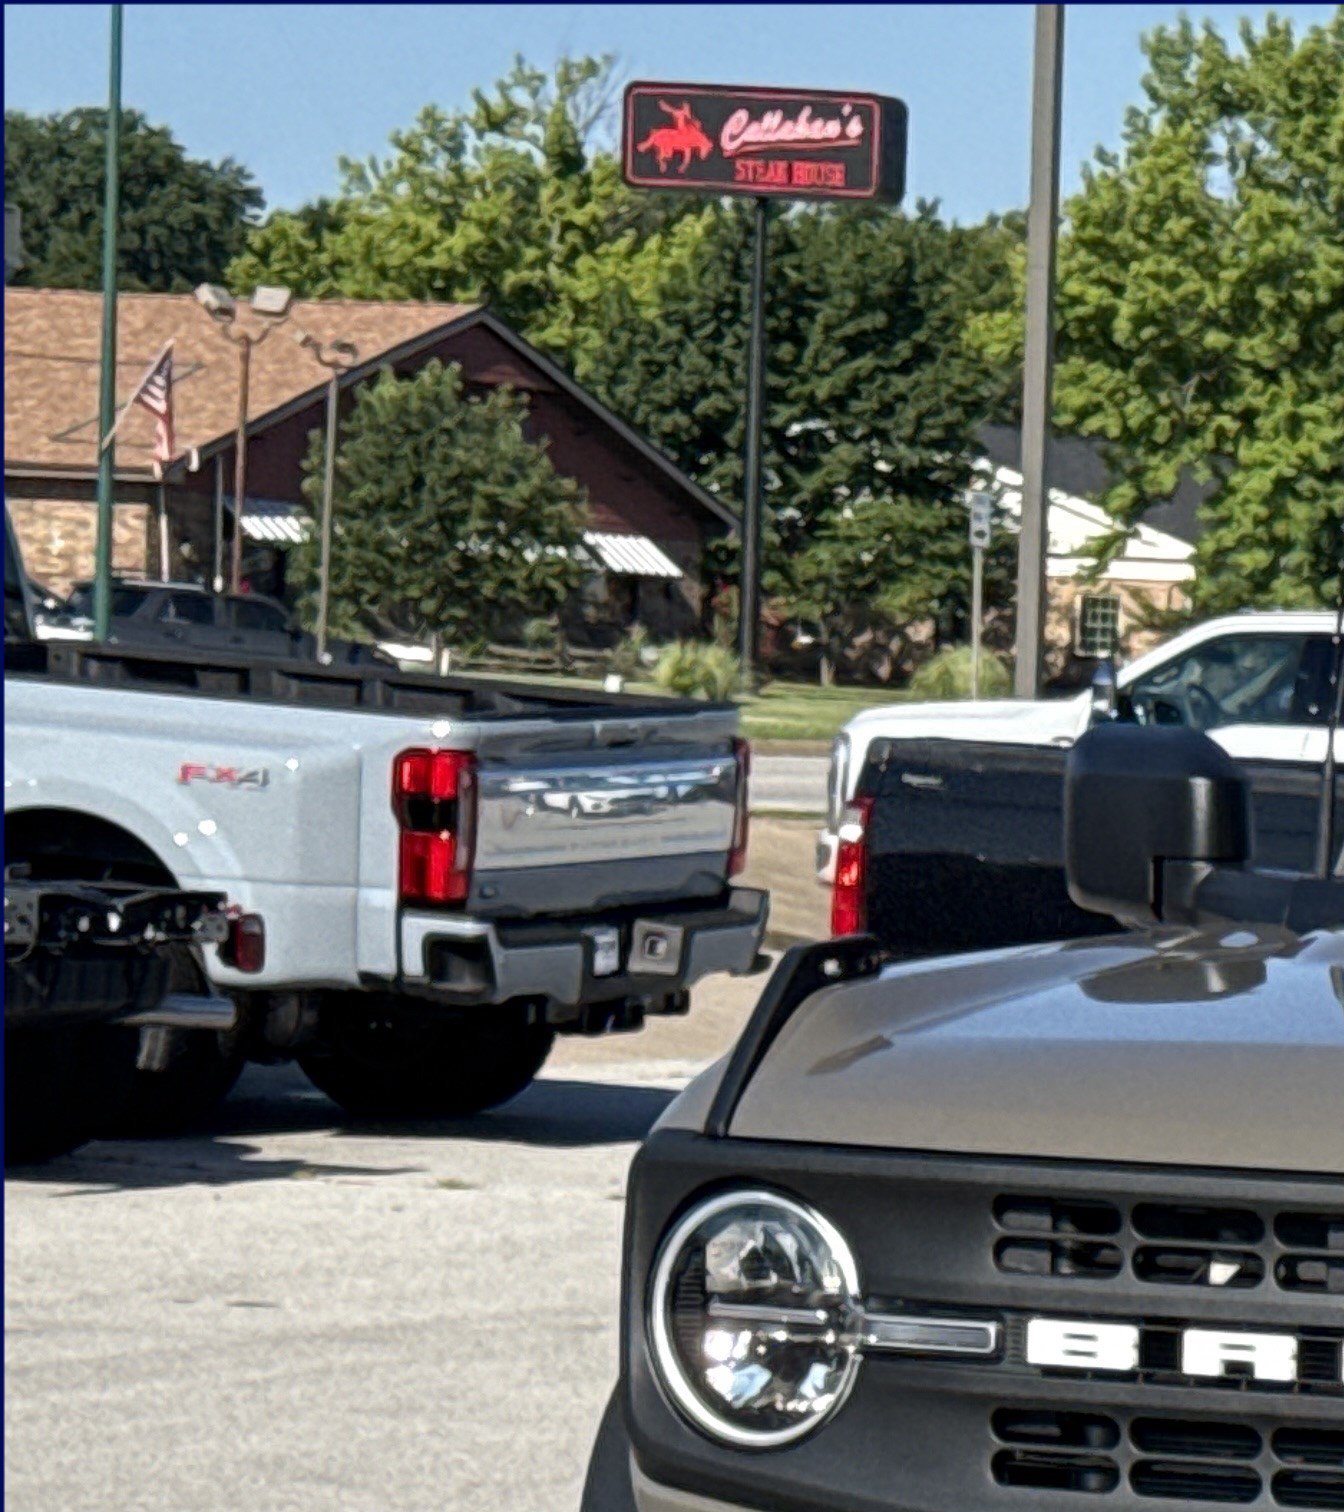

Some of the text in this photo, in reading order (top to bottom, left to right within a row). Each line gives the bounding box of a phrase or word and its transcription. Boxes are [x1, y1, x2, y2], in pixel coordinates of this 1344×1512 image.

[735, 159, 847, 188] STEAK HOUSE
[178, 763, 271, 787] FX4
